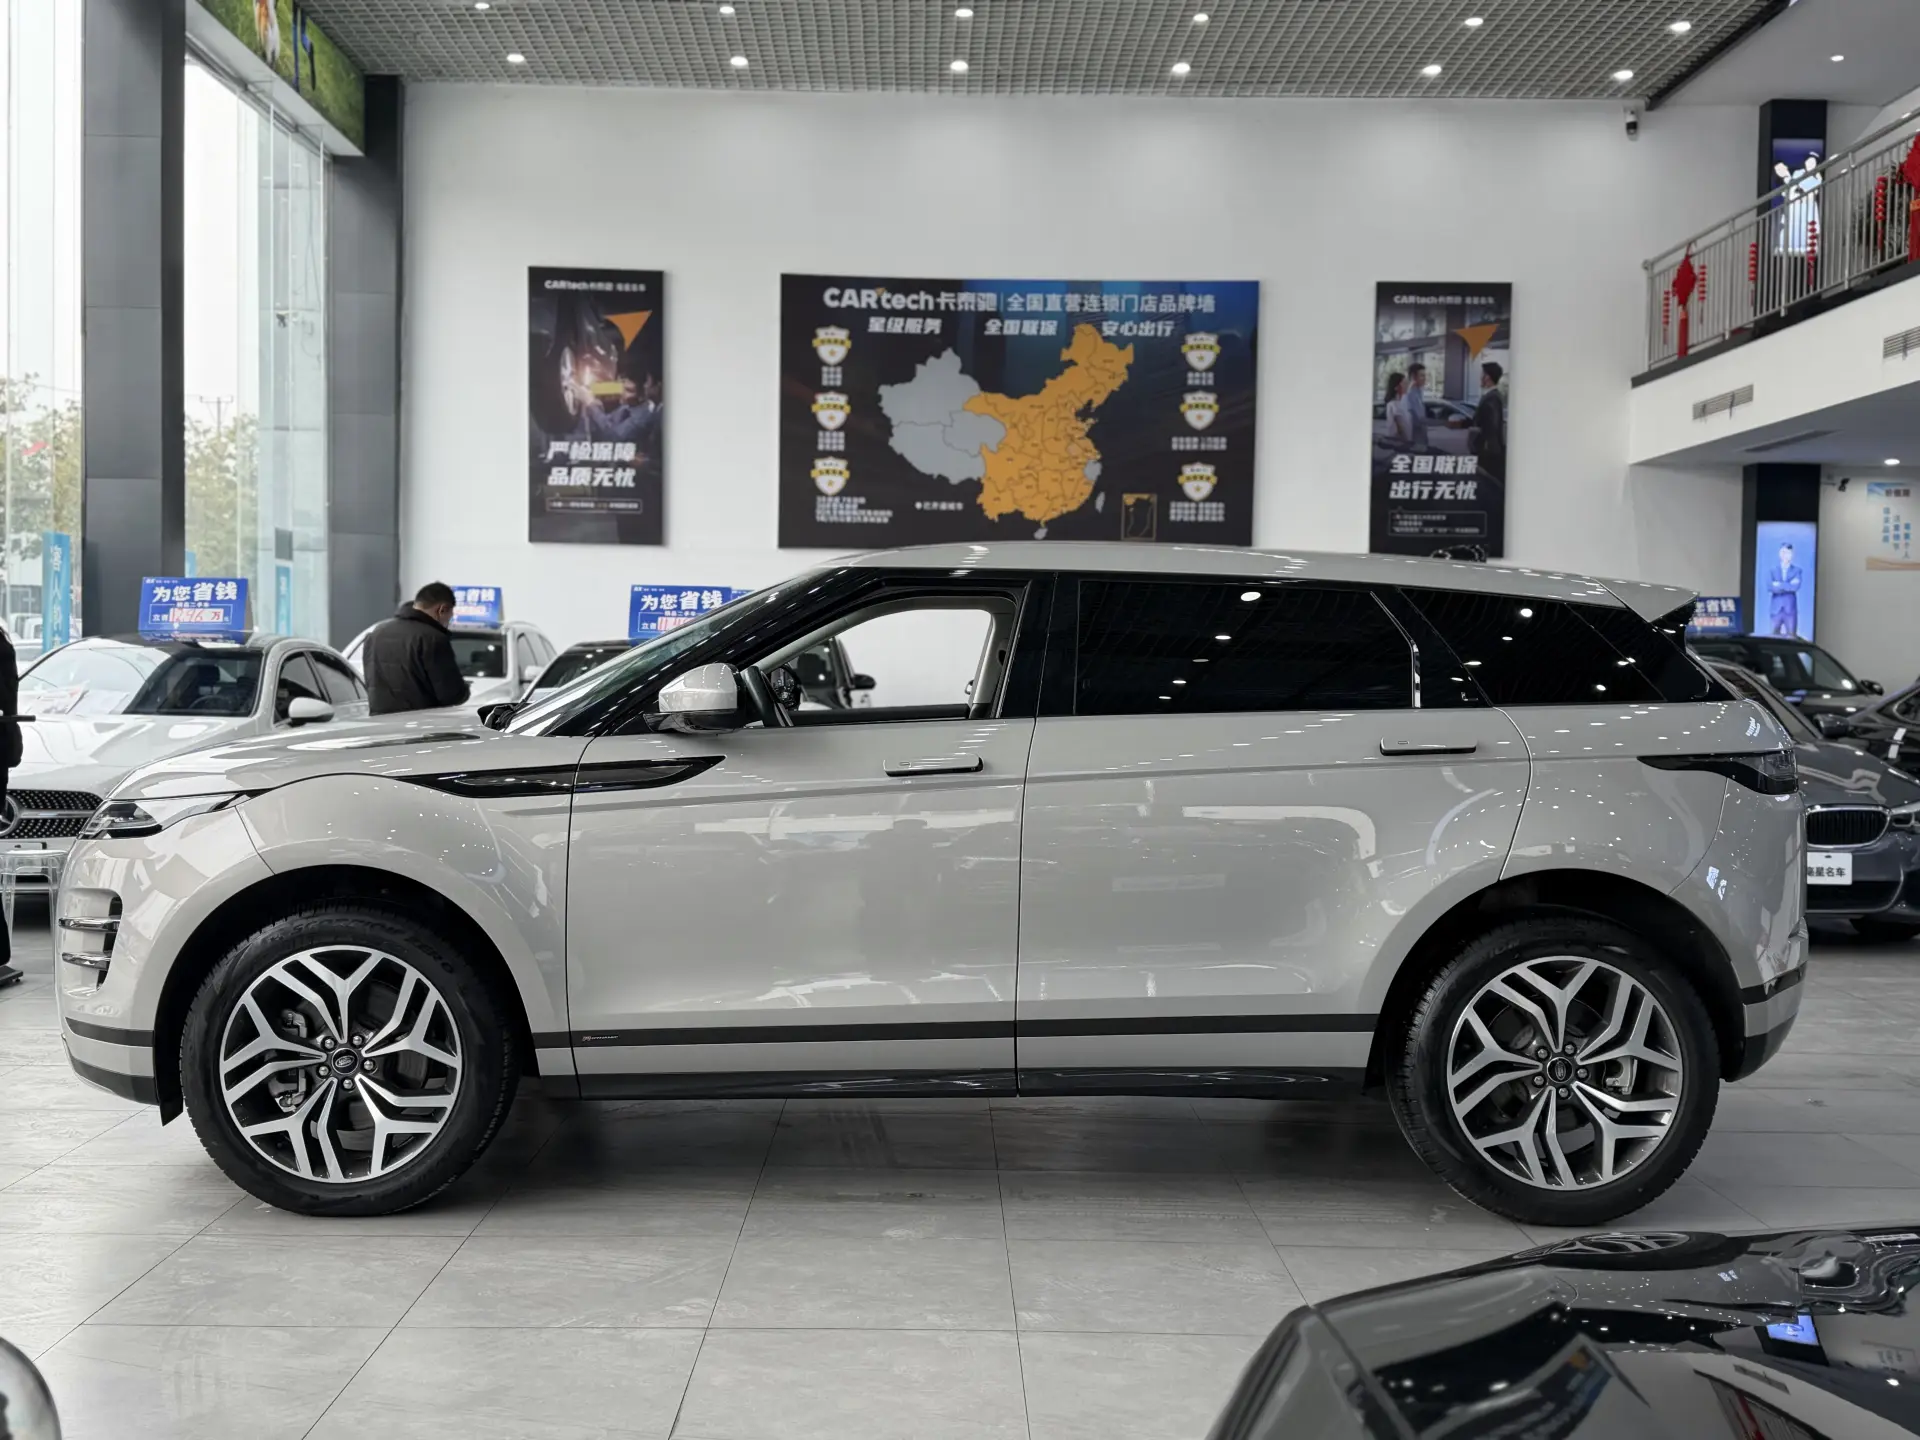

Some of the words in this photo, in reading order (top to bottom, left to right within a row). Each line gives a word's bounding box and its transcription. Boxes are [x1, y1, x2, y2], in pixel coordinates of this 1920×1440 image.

[936, 291, 998, 312] 卡泰驰
[1007, 292, 1217, 314] 全国直营连锁门店品牌墙
[867, 316, 943, 334] 星级服务
[1100, 318, 1176, 337] 安心出行
[1389, 455, 1478, 475] 全国联保
[547, 467, 636, 488] 品质无忧
[1388, 480, 1477, 500] 出行无忧
[152, 581, 238, 603] 为您省钱
[640, 589, 723, 611] 为您省钱
